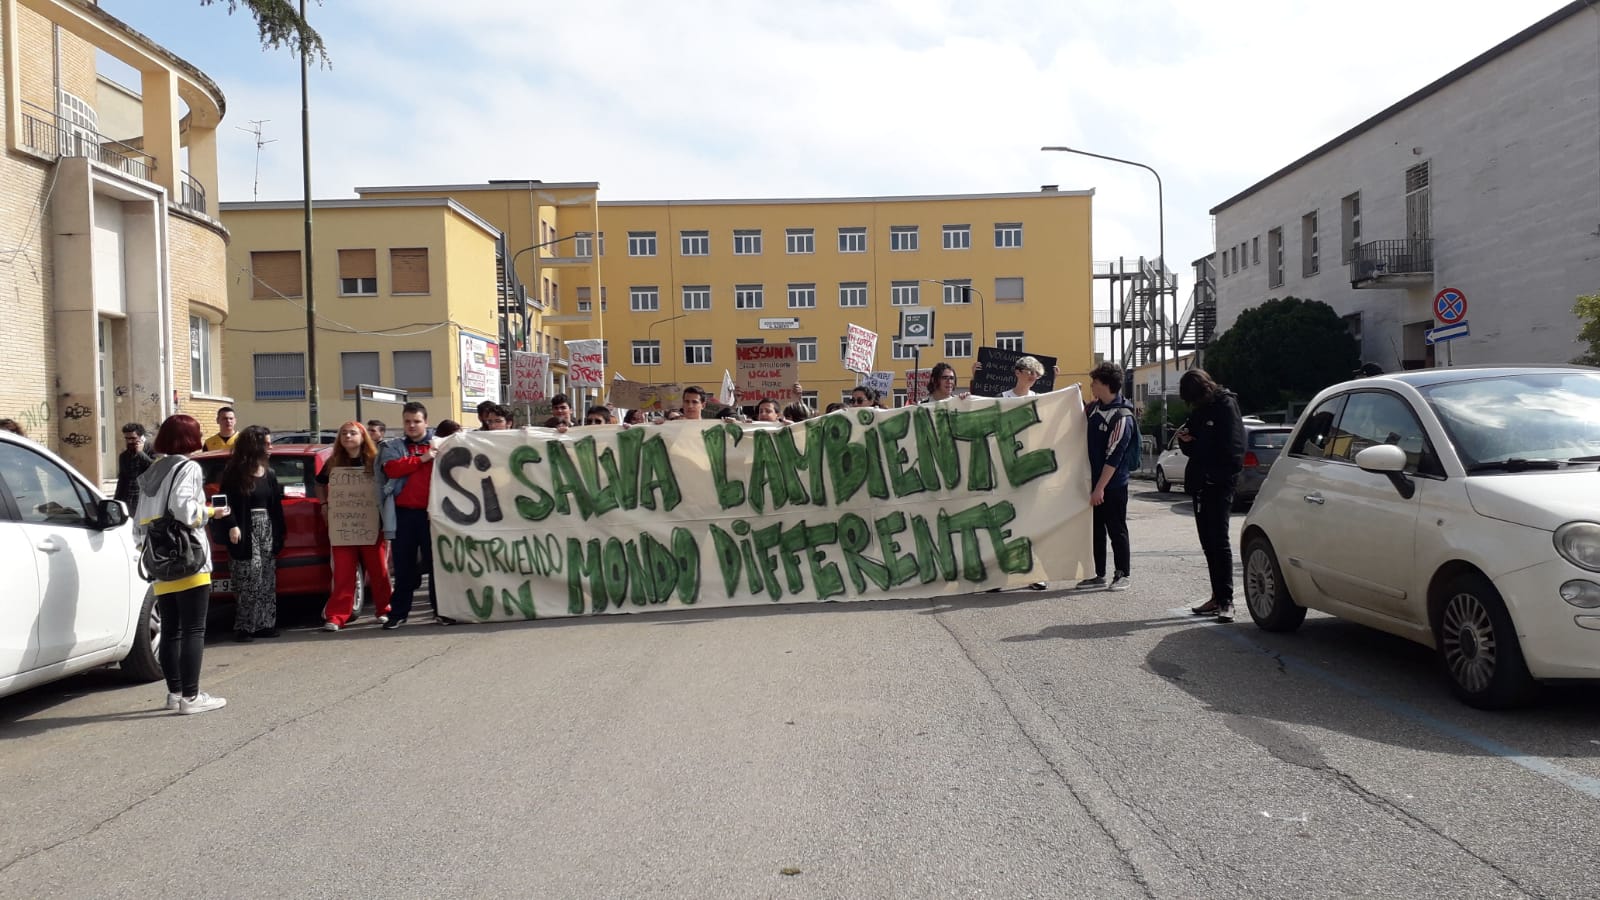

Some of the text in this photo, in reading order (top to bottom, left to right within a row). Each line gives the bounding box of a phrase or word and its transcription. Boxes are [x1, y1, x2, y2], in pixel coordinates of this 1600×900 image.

[736, 345, 794, 361] NESSUNA
[515, 354, 543, 368] LOTTA
[515, 368, 542, 379] DURA
[748, 369, 783, 379] UCCIDE
[517, 380, 539, 390] X LA
[514, 390, 545, 401] NATURA
[742, 388, 792, 401] AMBIENTE
[509, 427, 682, 521] SALVA
[335, 528, 377, 541] TEMPO
[437, 533, 564, 578] COSTRUENDO
[465, 580, 537, 620] UN
[567, 526, 702, 614] MONDO
